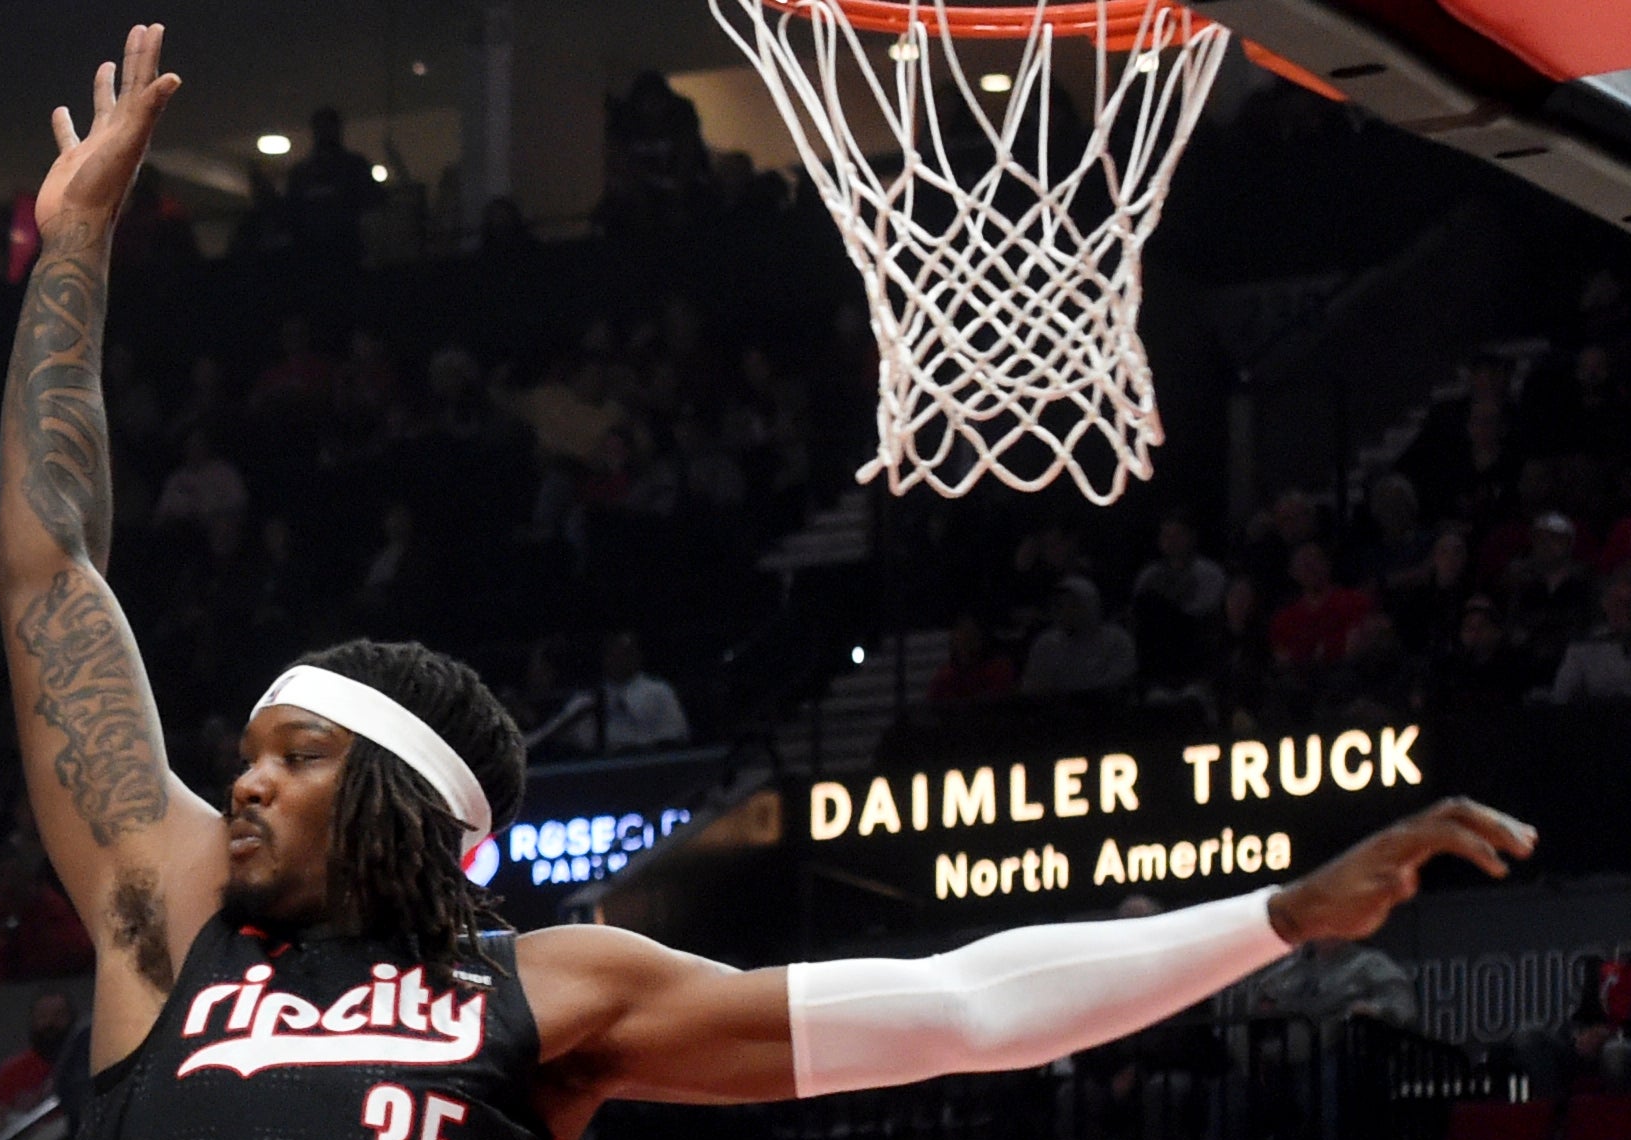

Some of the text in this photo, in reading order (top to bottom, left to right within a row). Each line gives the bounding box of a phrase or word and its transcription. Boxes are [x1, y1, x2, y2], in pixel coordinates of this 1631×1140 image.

[809, 724, 1423, 842] DAIMLER TRUCK
[935, 827, 1293, 900] North America
